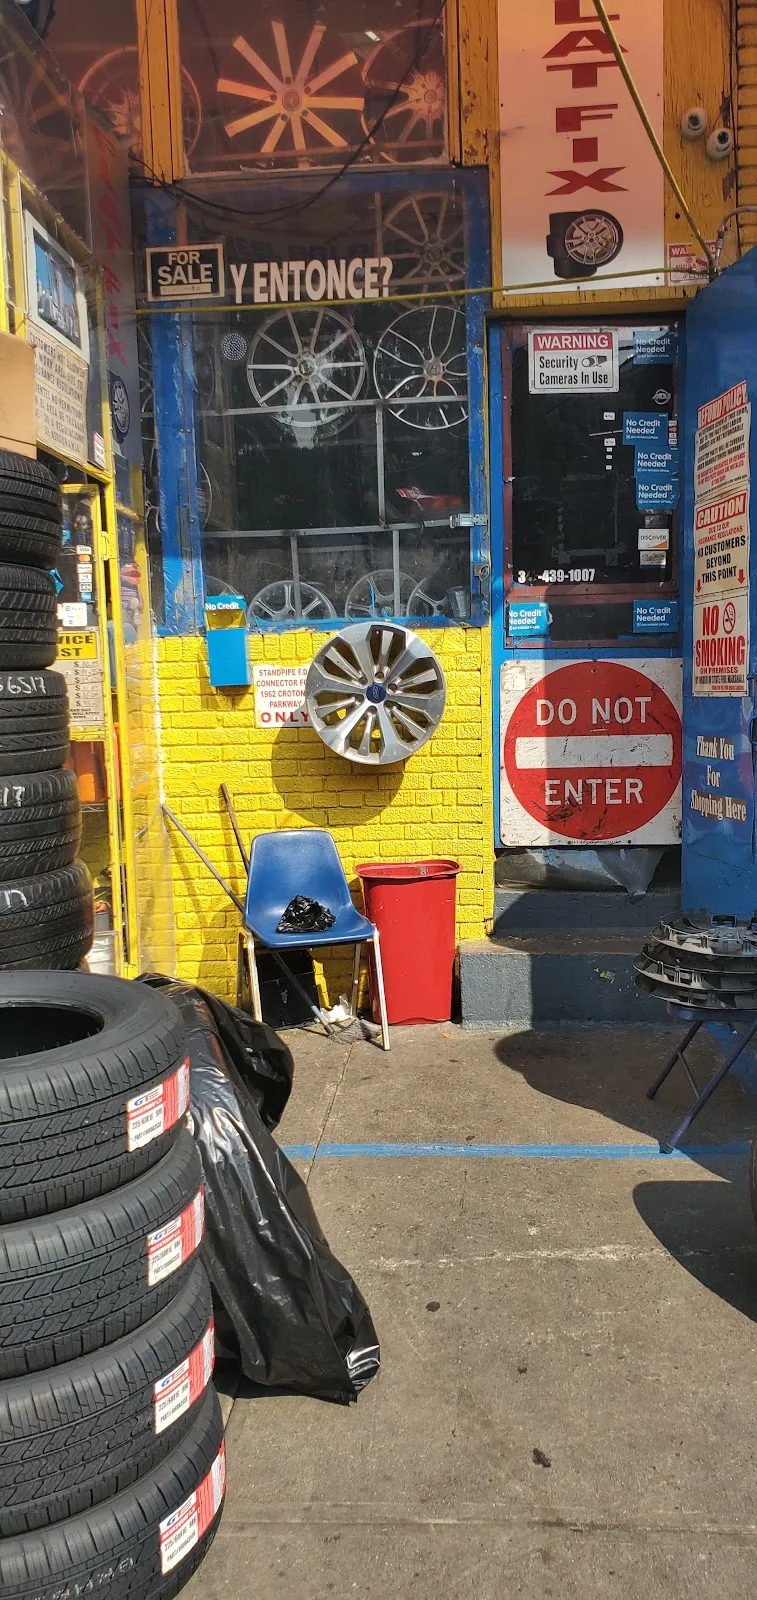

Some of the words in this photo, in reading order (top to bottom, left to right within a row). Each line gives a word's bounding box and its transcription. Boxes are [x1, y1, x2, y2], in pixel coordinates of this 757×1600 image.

[544, 104, 629, 196] FIX
[168, 251, 200, 264] FOR
[158, 264, 214, 285] SALE
[230, 264, 248, 304] Y
[254, 257, 393, 304] ENTONCE?
[537, 335, 608, 349] WARNING
[539, 356, 578, 370] Security
[539, 372, 578, 385] Cameras
[581, 372, 589, 384] In
[592, 372, 608, 384] Use
[722, 384, 747, 415] POLICY
[698, 496, 745, 528] CAUTION
[718, 525, 743, 540] REGULATIONS
[698, 547, 703, 558] NO
[705, 536, 746, 556] CUSTOMERS
[706, 553, 731, 569] BEYOND
[518, 569, 596, 583] 3-439-1007
[702, 570, 716, 584] THIS
[718, 566, 737, 580] POINT
[218, 602, 239, 610] Credit
[702, 605, 719, 636] NO
[696, 636, 745, 667] SMOKING
[700, 668, 708, 676] ON
[709, 666, 738, 676] PREMISES
[261, 711, 309, 723] ONLY
[536, 698, 577, 726] DO
[592, 696, 651, 724] NOT
[696, 735, 717, 758] Thank
[720, 737, 734, 760] You
[707, 765, 720, 787] For
[544, 777, 644, 805] ENTER
[691, 789, 723, 820] Shopping
[725, 797, 747, 821] Here
